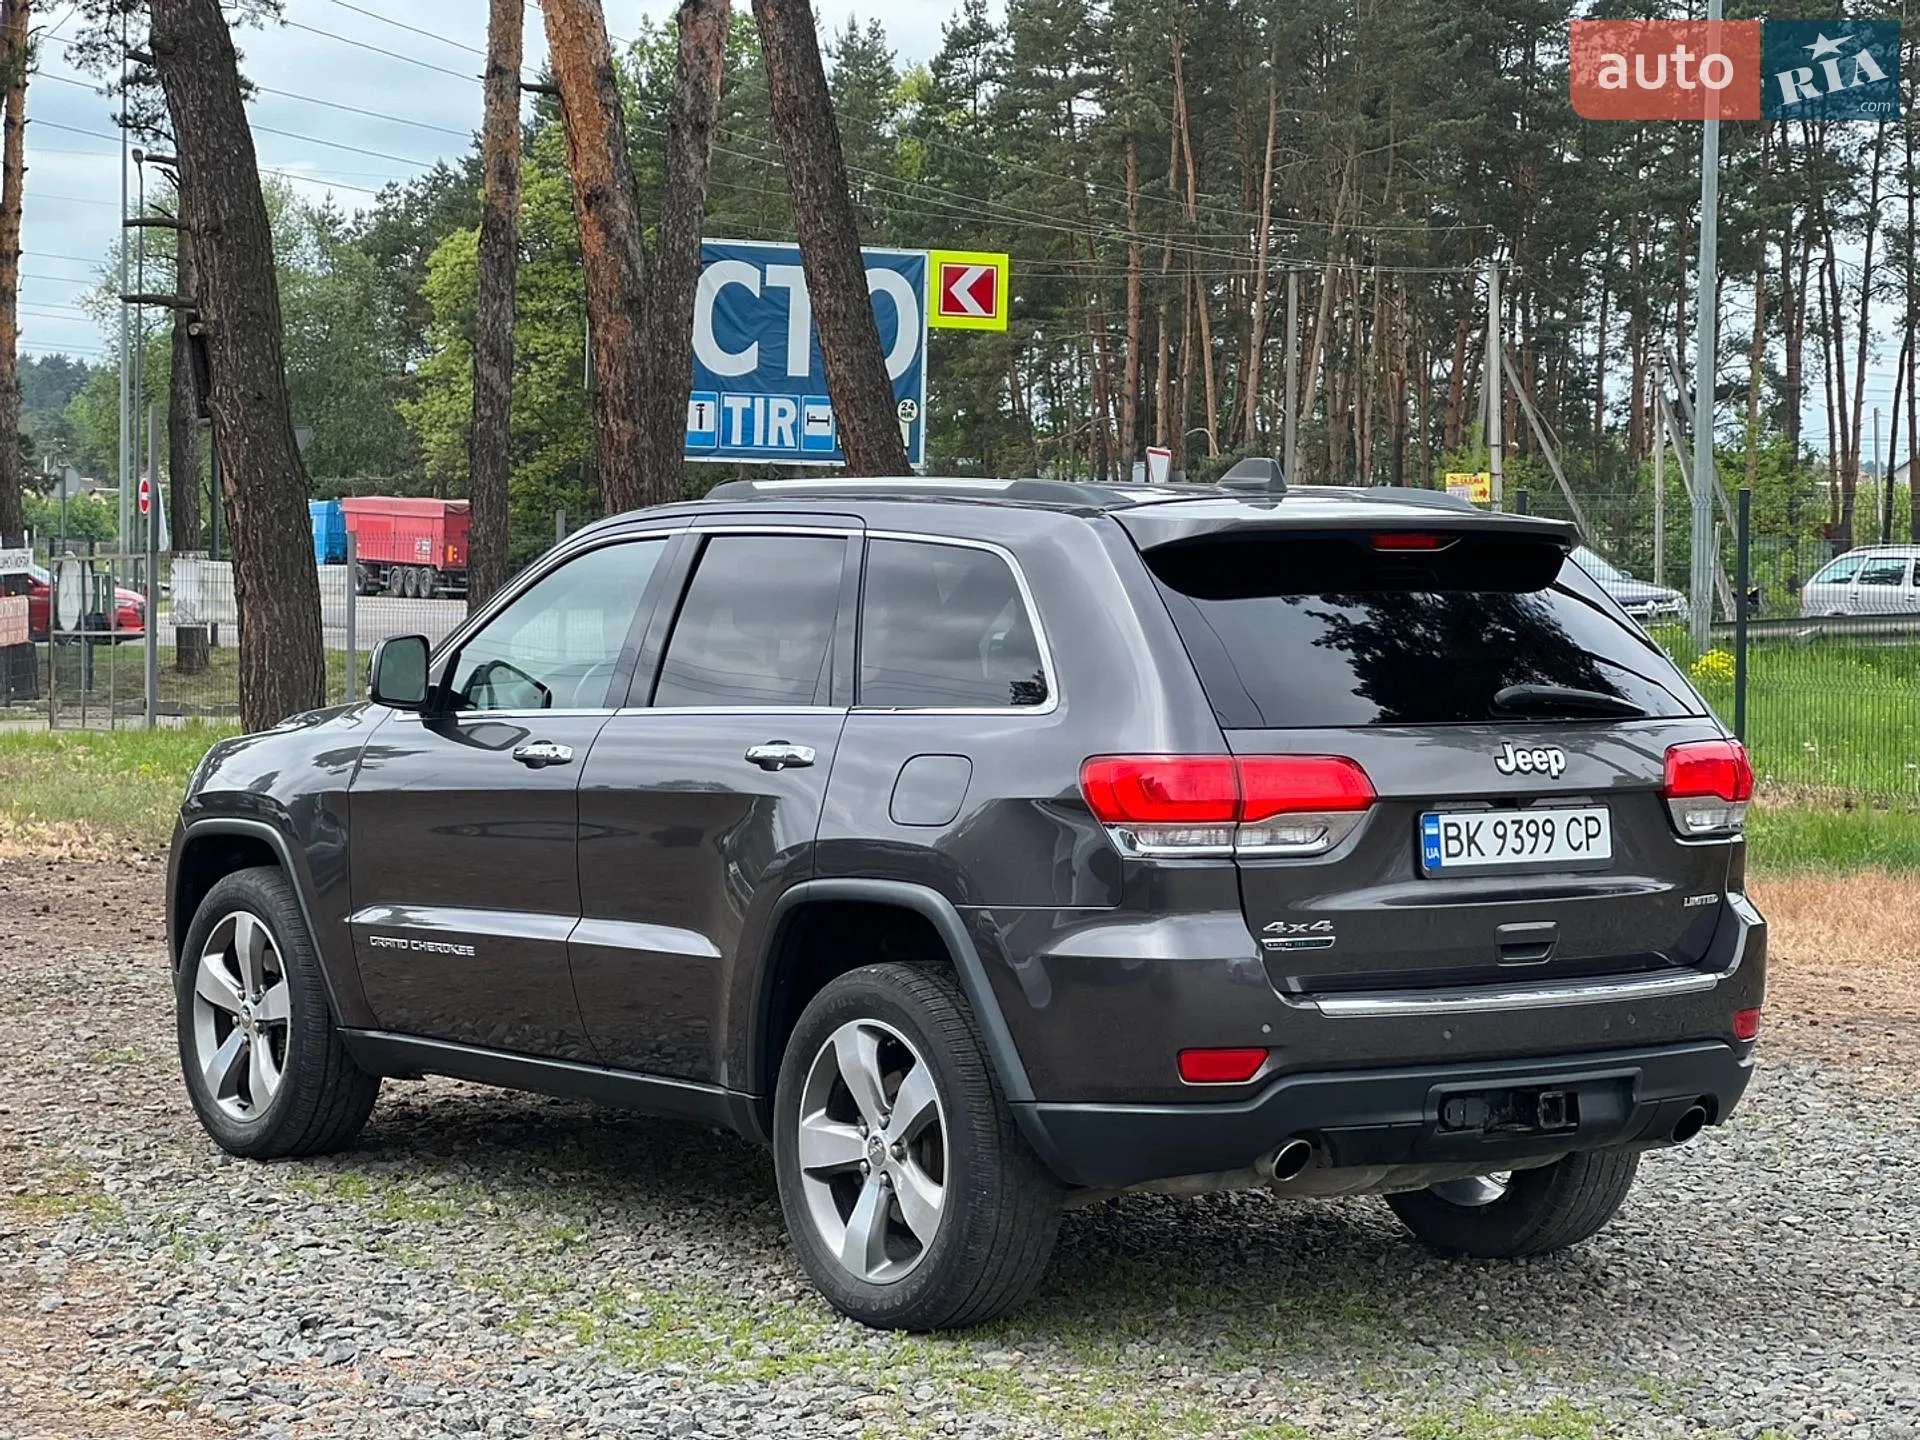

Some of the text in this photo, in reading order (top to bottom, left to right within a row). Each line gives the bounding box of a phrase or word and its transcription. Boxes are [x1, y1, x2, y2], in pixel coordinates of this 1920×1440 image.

[723, 397, 798, 447] TIR
[901, 402, 915, 410] 24
[1494, 741, 1567, 779] Jeep
[1443, 815, 1601, 859] BK 9399 CP
[369, 935, 476, 956] GRAND CHEROKEE
